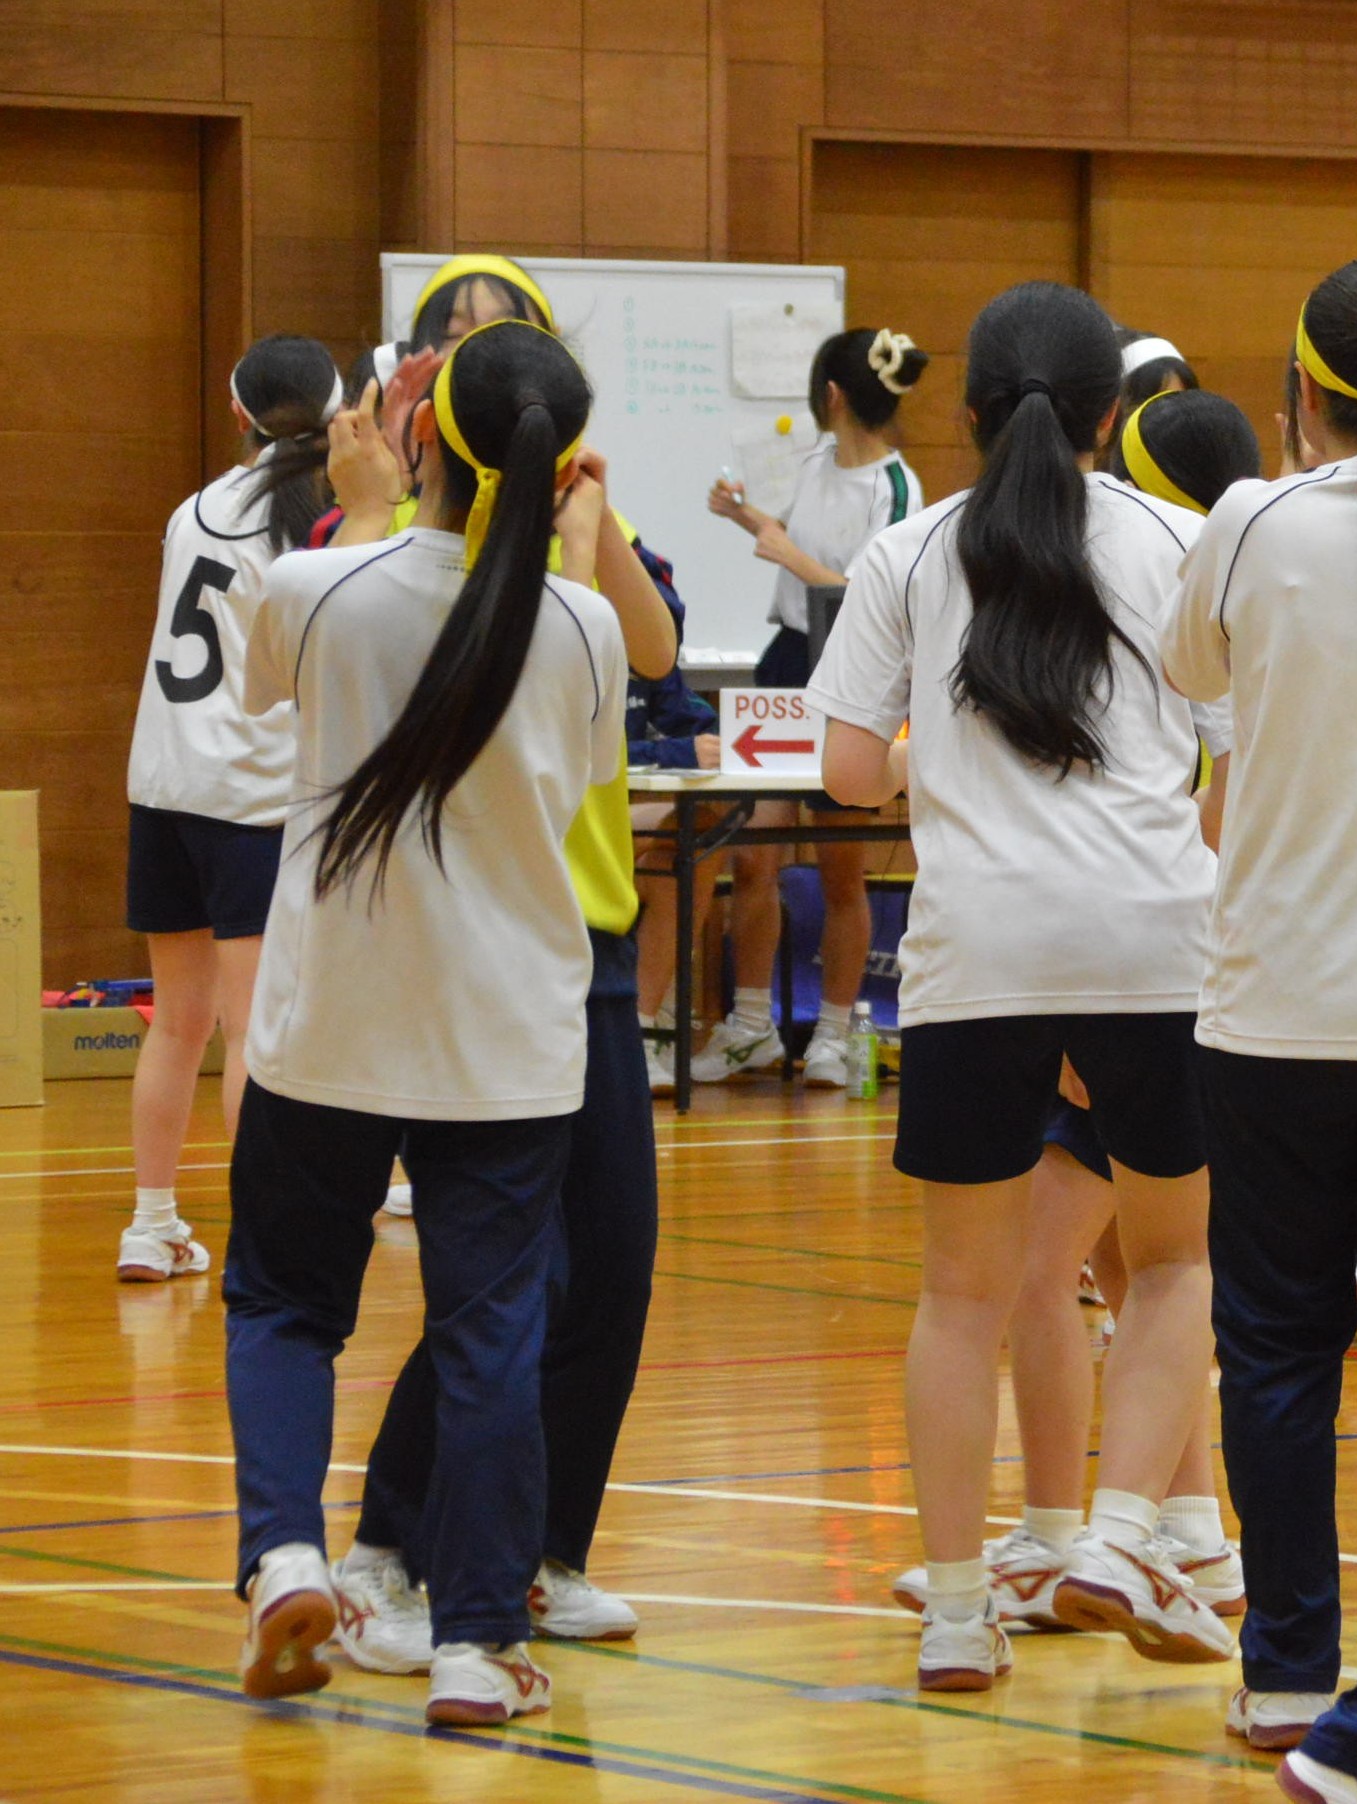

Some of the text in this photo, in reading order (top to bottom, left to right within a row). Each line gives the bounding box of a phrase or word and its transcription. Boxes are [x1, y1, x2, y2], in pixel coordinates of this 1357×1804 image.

[155, 555, 237, 703] 5
[735, 695, 810, 720] POSS.
[74, 1031, 140, 1051] molten
